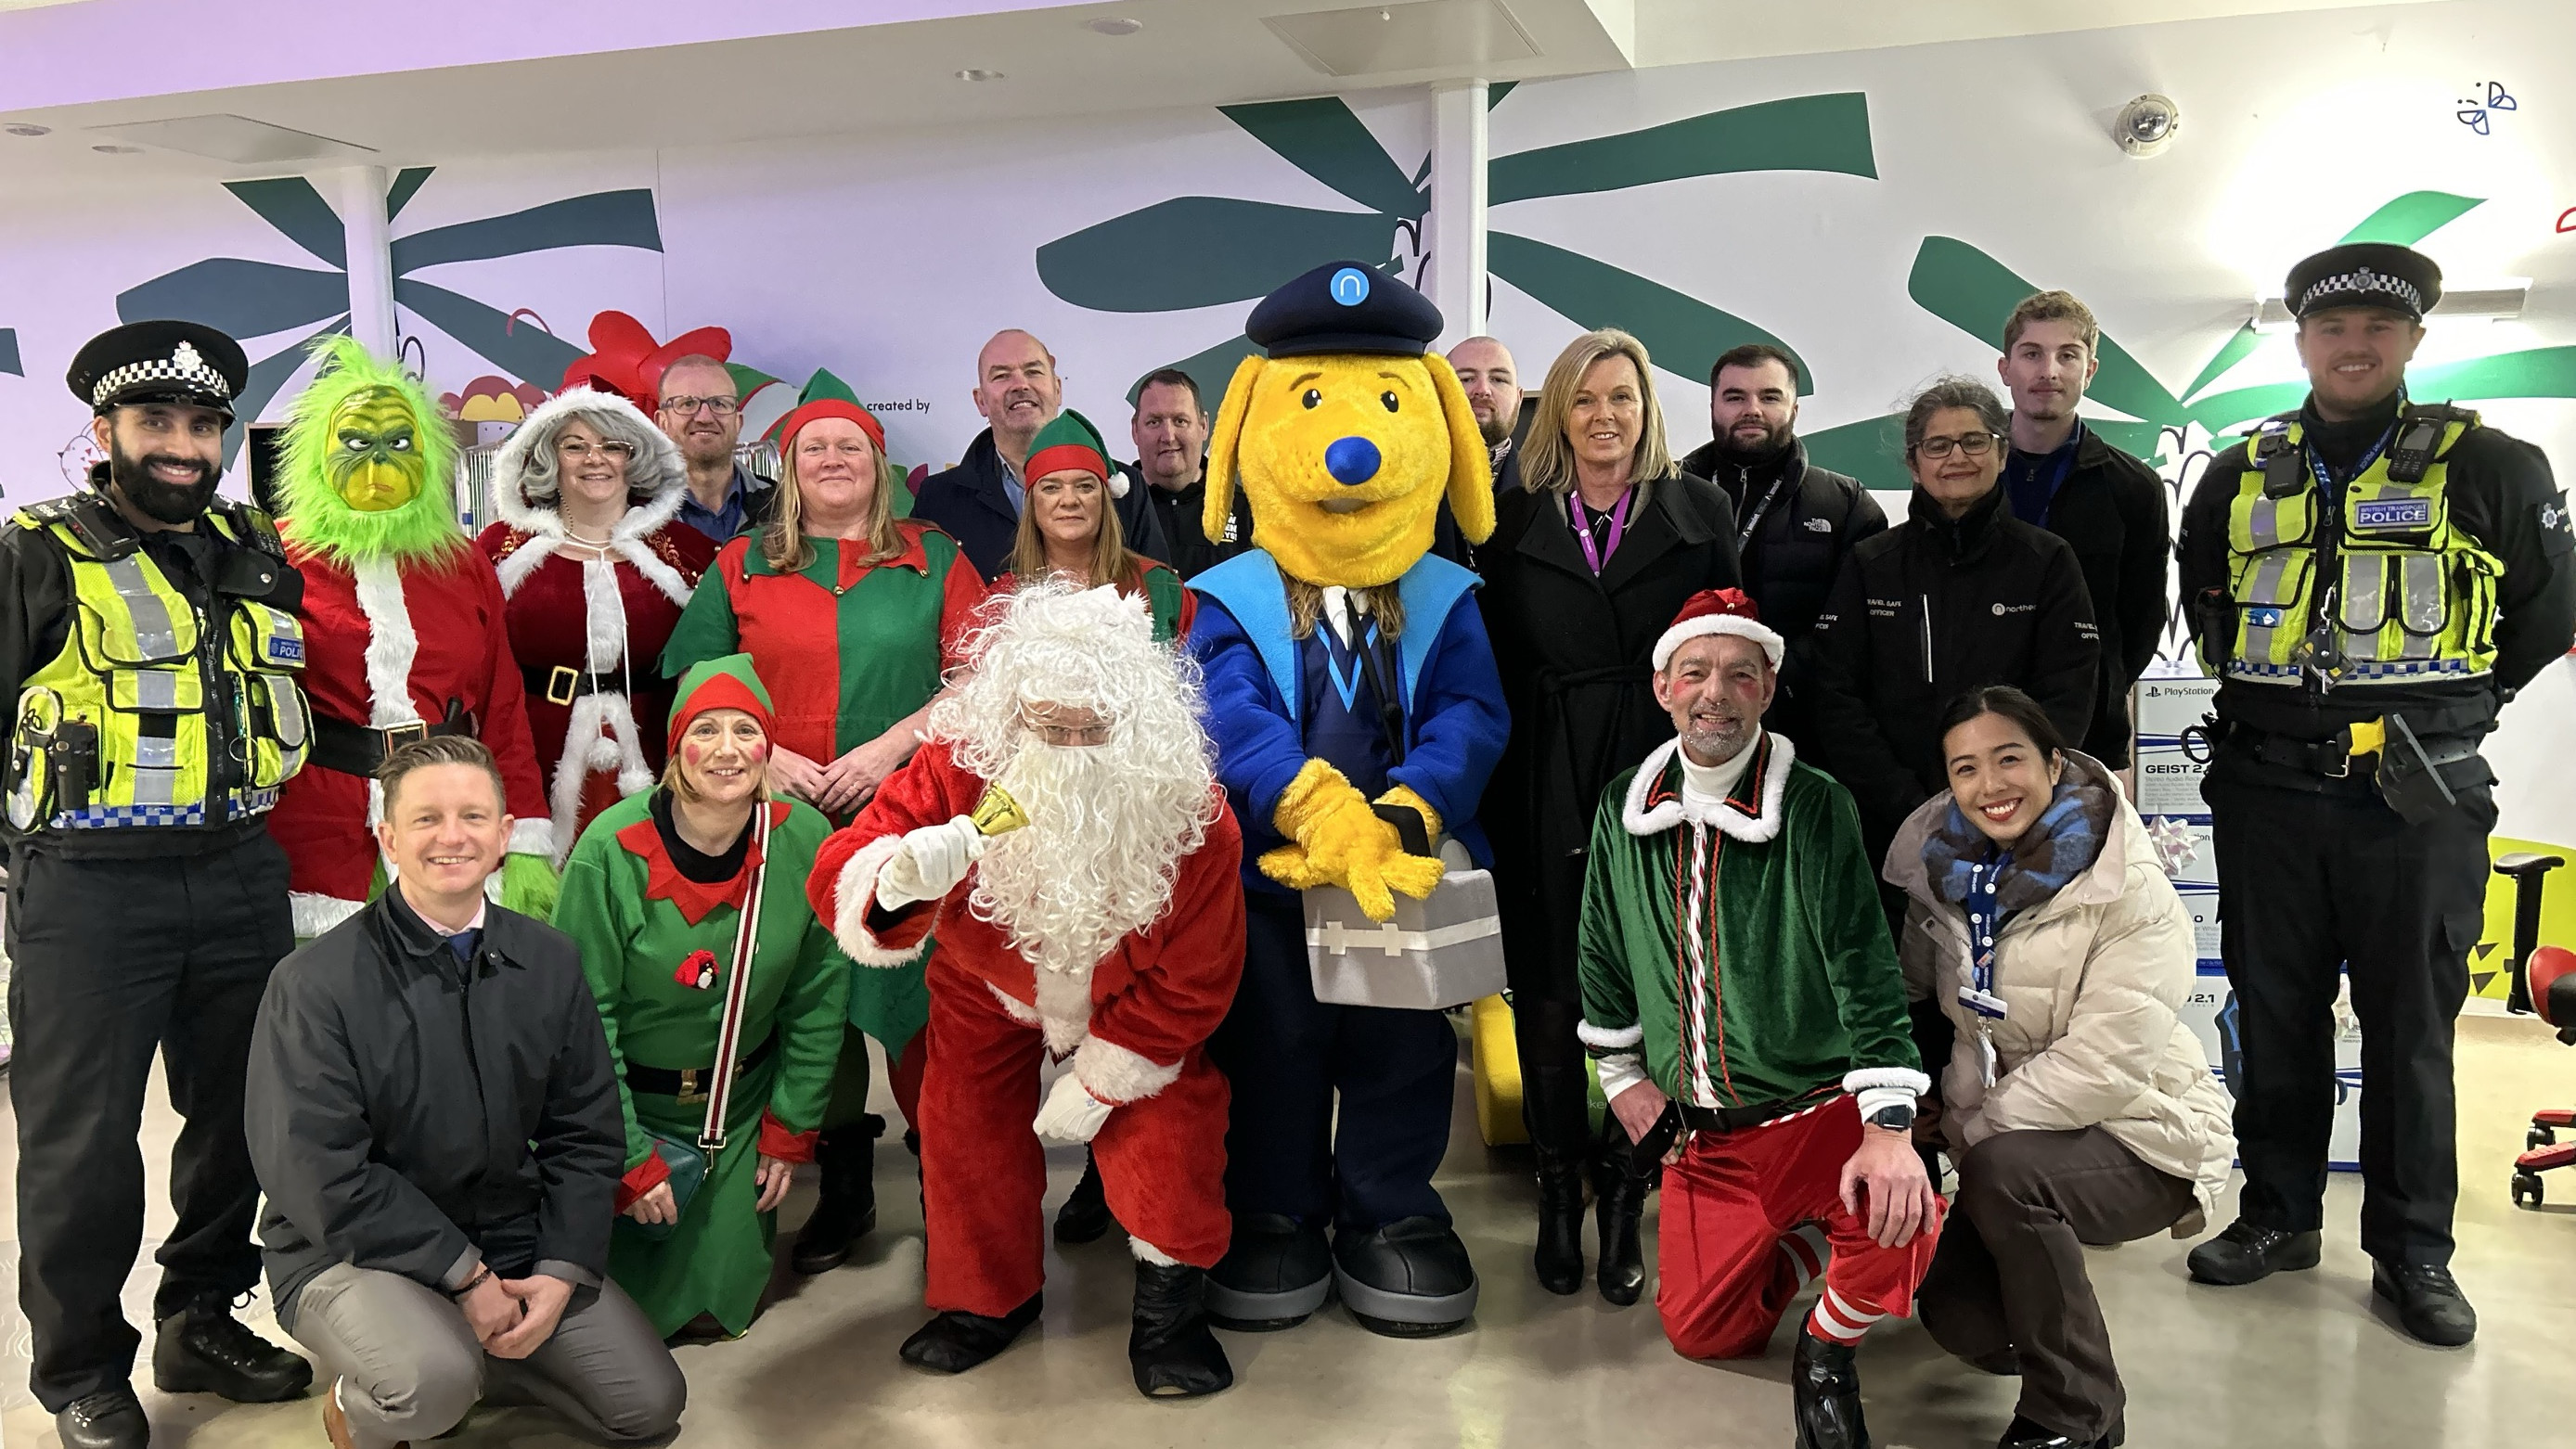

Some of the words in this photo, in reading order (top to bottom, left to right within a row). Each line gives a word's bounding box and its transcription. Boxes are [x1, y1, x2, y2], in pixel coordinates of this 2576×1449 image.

[867, 399, 912, 411] created
[916, 399, 930, 414] by
[2388, 504, 2426, 512] TRANSPORT
[2360, 510, 2426, 522] POLICE
[1867, 598, 1886, 607] RAVEL
[279, 646, 300, 657] POLI
[2164, 687, 2214, 698] PlayStation
[2145, 764, 2189, 774] GEIST
[2195, 994, 2215, 1003] 2.1
